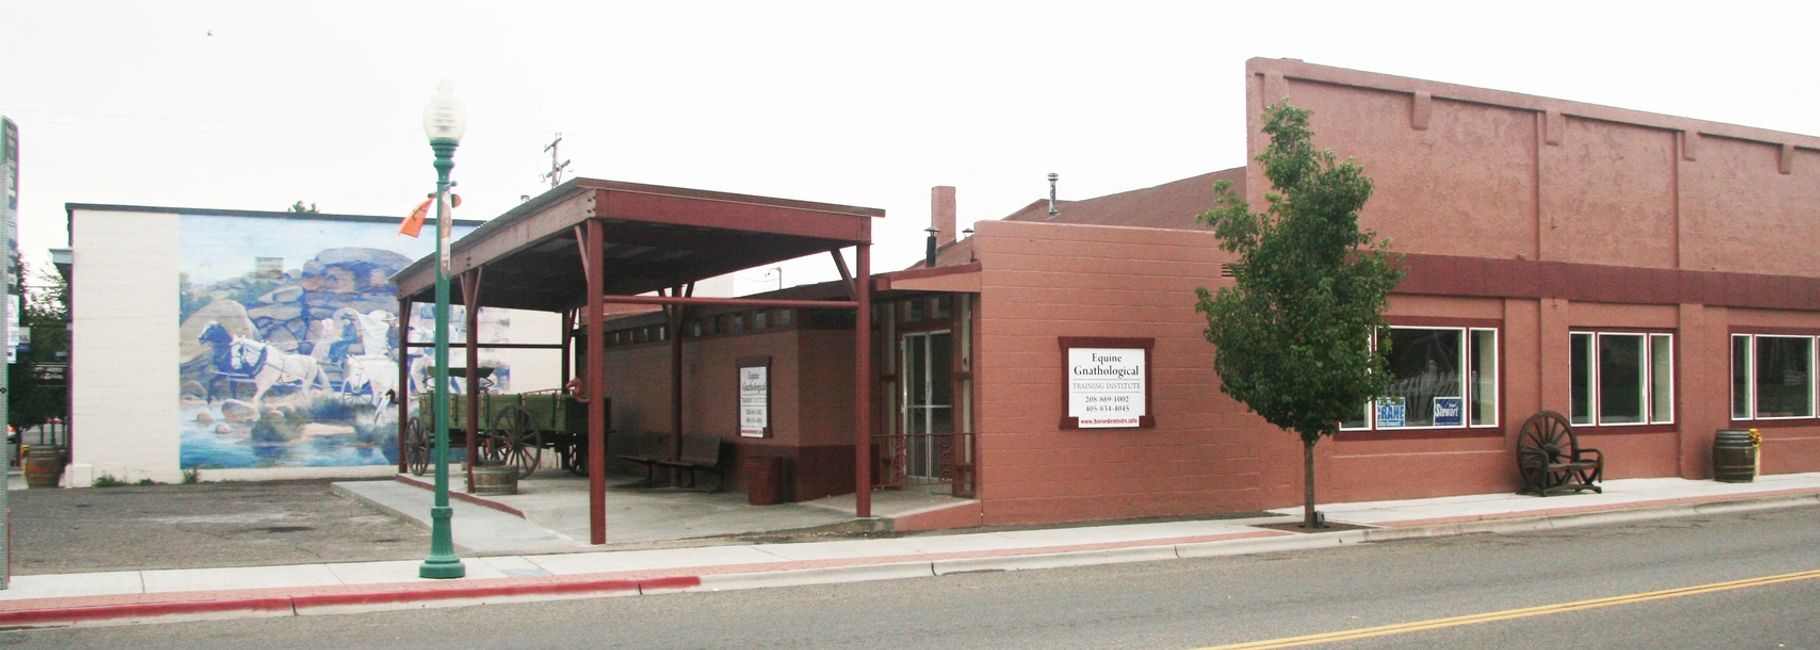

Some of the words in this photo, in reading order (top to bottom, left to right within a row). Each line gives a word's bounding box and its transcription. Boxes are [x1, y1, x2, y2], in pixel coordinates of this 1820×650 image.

[1092, 353, 1122, 365] Equine
[1073, 365, 1139, 379] Gnathological
[1435, 403, 1459, 417] Stewart
